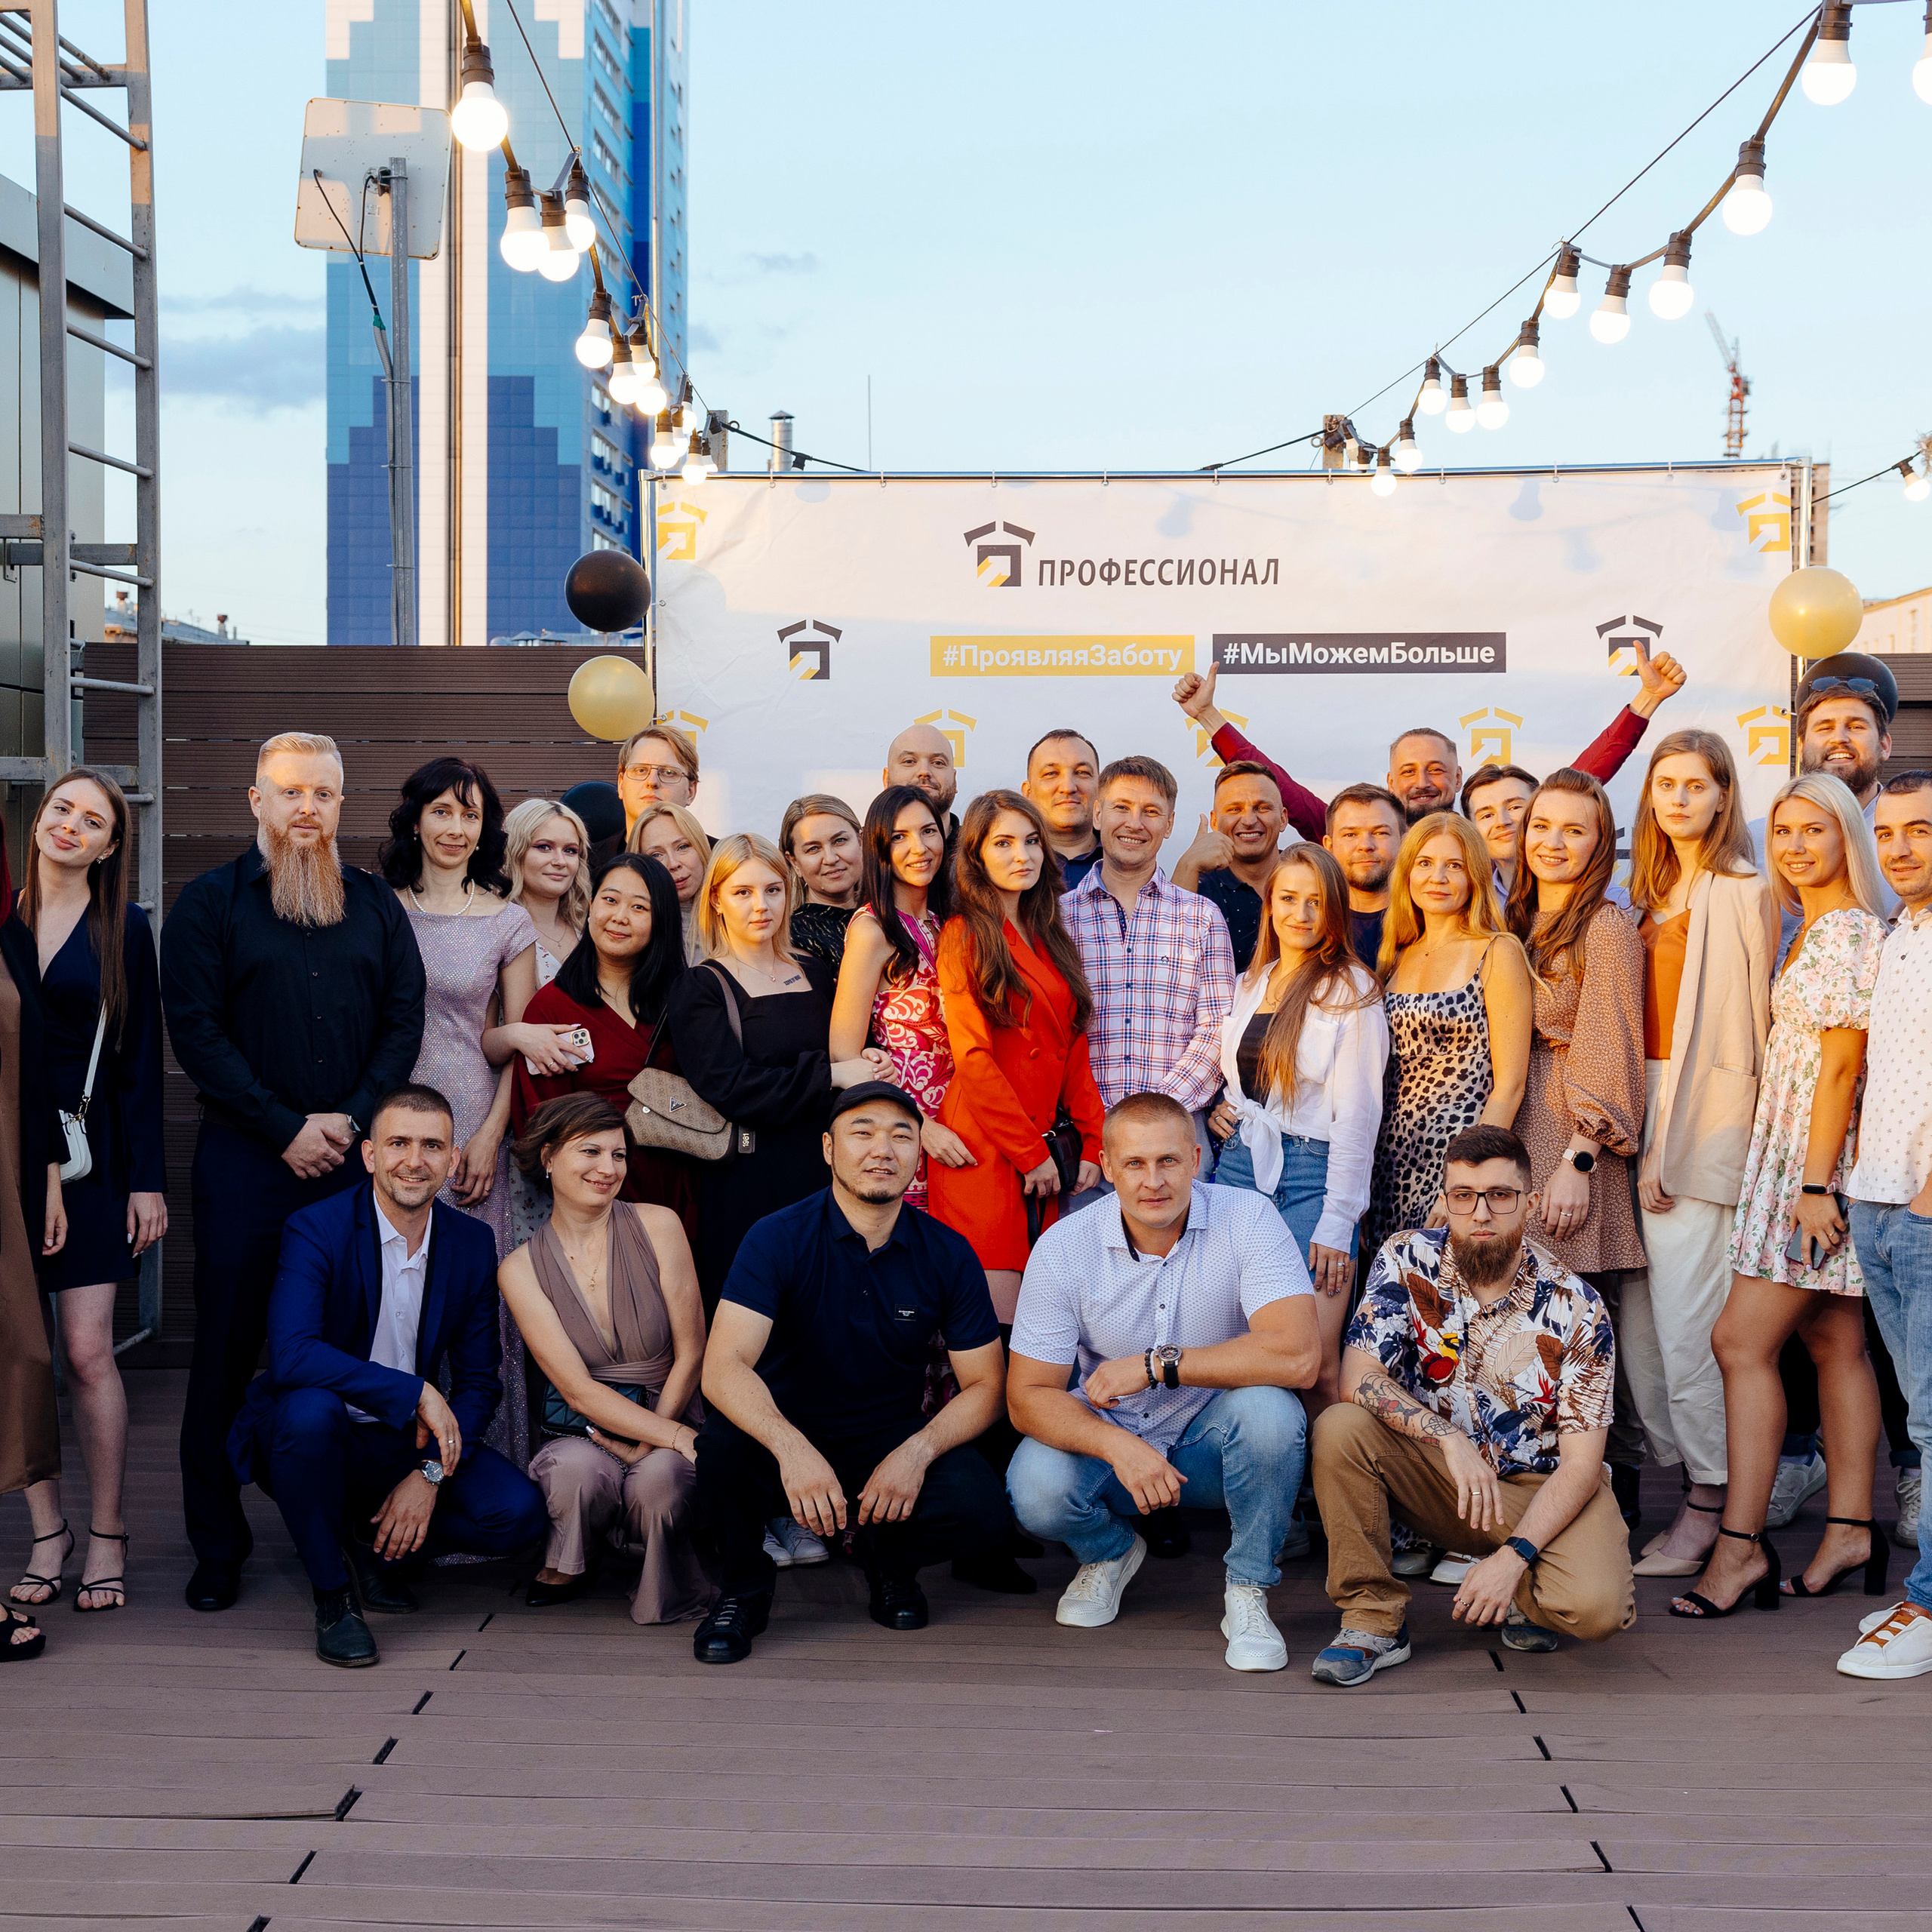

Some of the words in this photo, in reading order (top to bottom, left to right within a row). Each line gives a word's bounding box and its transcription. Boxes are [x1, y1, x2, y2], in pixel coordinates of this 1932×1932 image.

[1038, 558, 1279, 586] ПРОФЕССИОНАЛ
[943, 643, 1183, 672] #ПроявляяЗаботу
[1223, 641, 1495, 664] #МыМожемБольше
